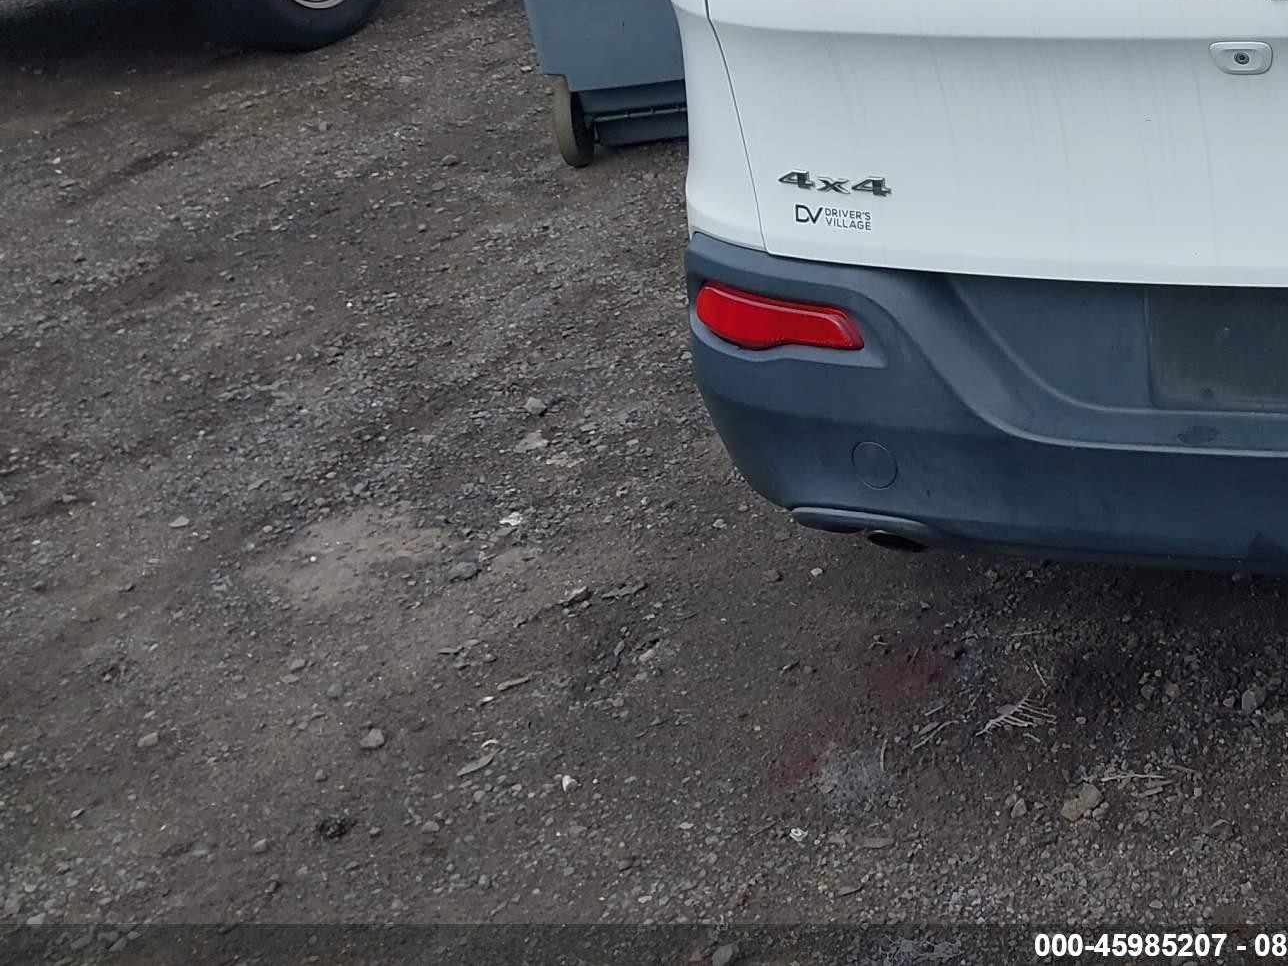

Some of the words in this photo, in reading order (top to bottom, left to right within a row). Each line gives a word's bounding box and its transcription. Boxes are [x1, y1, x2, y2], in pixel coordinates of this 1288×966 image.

[777, 168, 893, 197] 4x4
[795, 204, 823, 224] DV
[825, 207, 871, 221] DRIVER'S
[825, 217, 871, 230] VILLAGE
